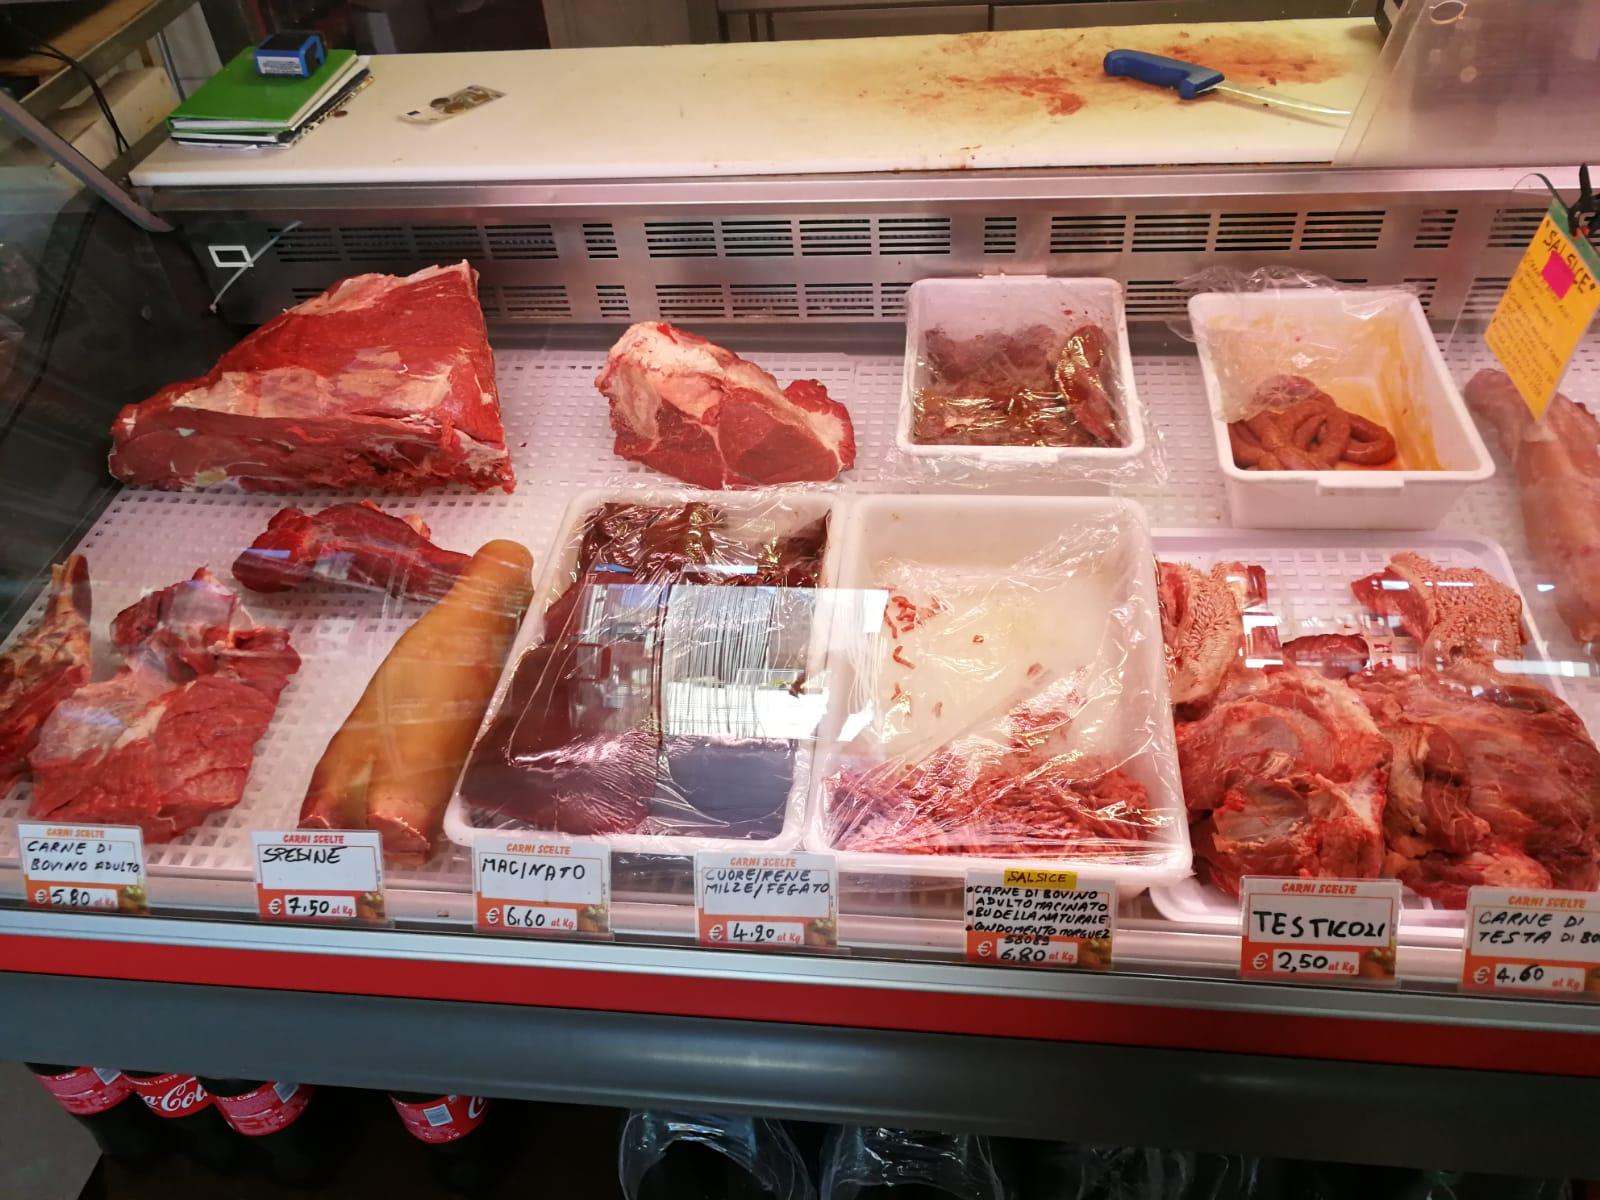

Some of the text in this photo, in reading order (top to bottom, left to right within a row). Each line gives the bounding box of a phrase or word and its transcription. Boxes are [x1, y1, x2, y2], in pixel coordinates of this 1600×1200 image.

[283, 834, 345, 844] CARNI SCELTE
[27, 840, 112, 855] CARNE DI
[506, 843, 572, 856] CARNI SCELTE
[31, 858, 88, 871] BOVINO
[481, 858, 586, 881] MACINATO
[730, 857, 797, 868] CARNI SCELTE
[1007, 870, 1067, 883] SALSICE
[974, 885, 1098, 901] CARNE DI BOVINO
[1281, 883, 1357, 895] CARNI SCELTE
[976, 896, 1108, 912] ADULTO MACINATO
[1508, 895, 1544, 906] CARNI
[975, 907, 1109, 925] BUDELLA NATURALE
[1479, 911, 1585, 928] CARNE DI
[1479, 930, 1552, 945] TESTA
[1560, 933, 1575, 943] DI
